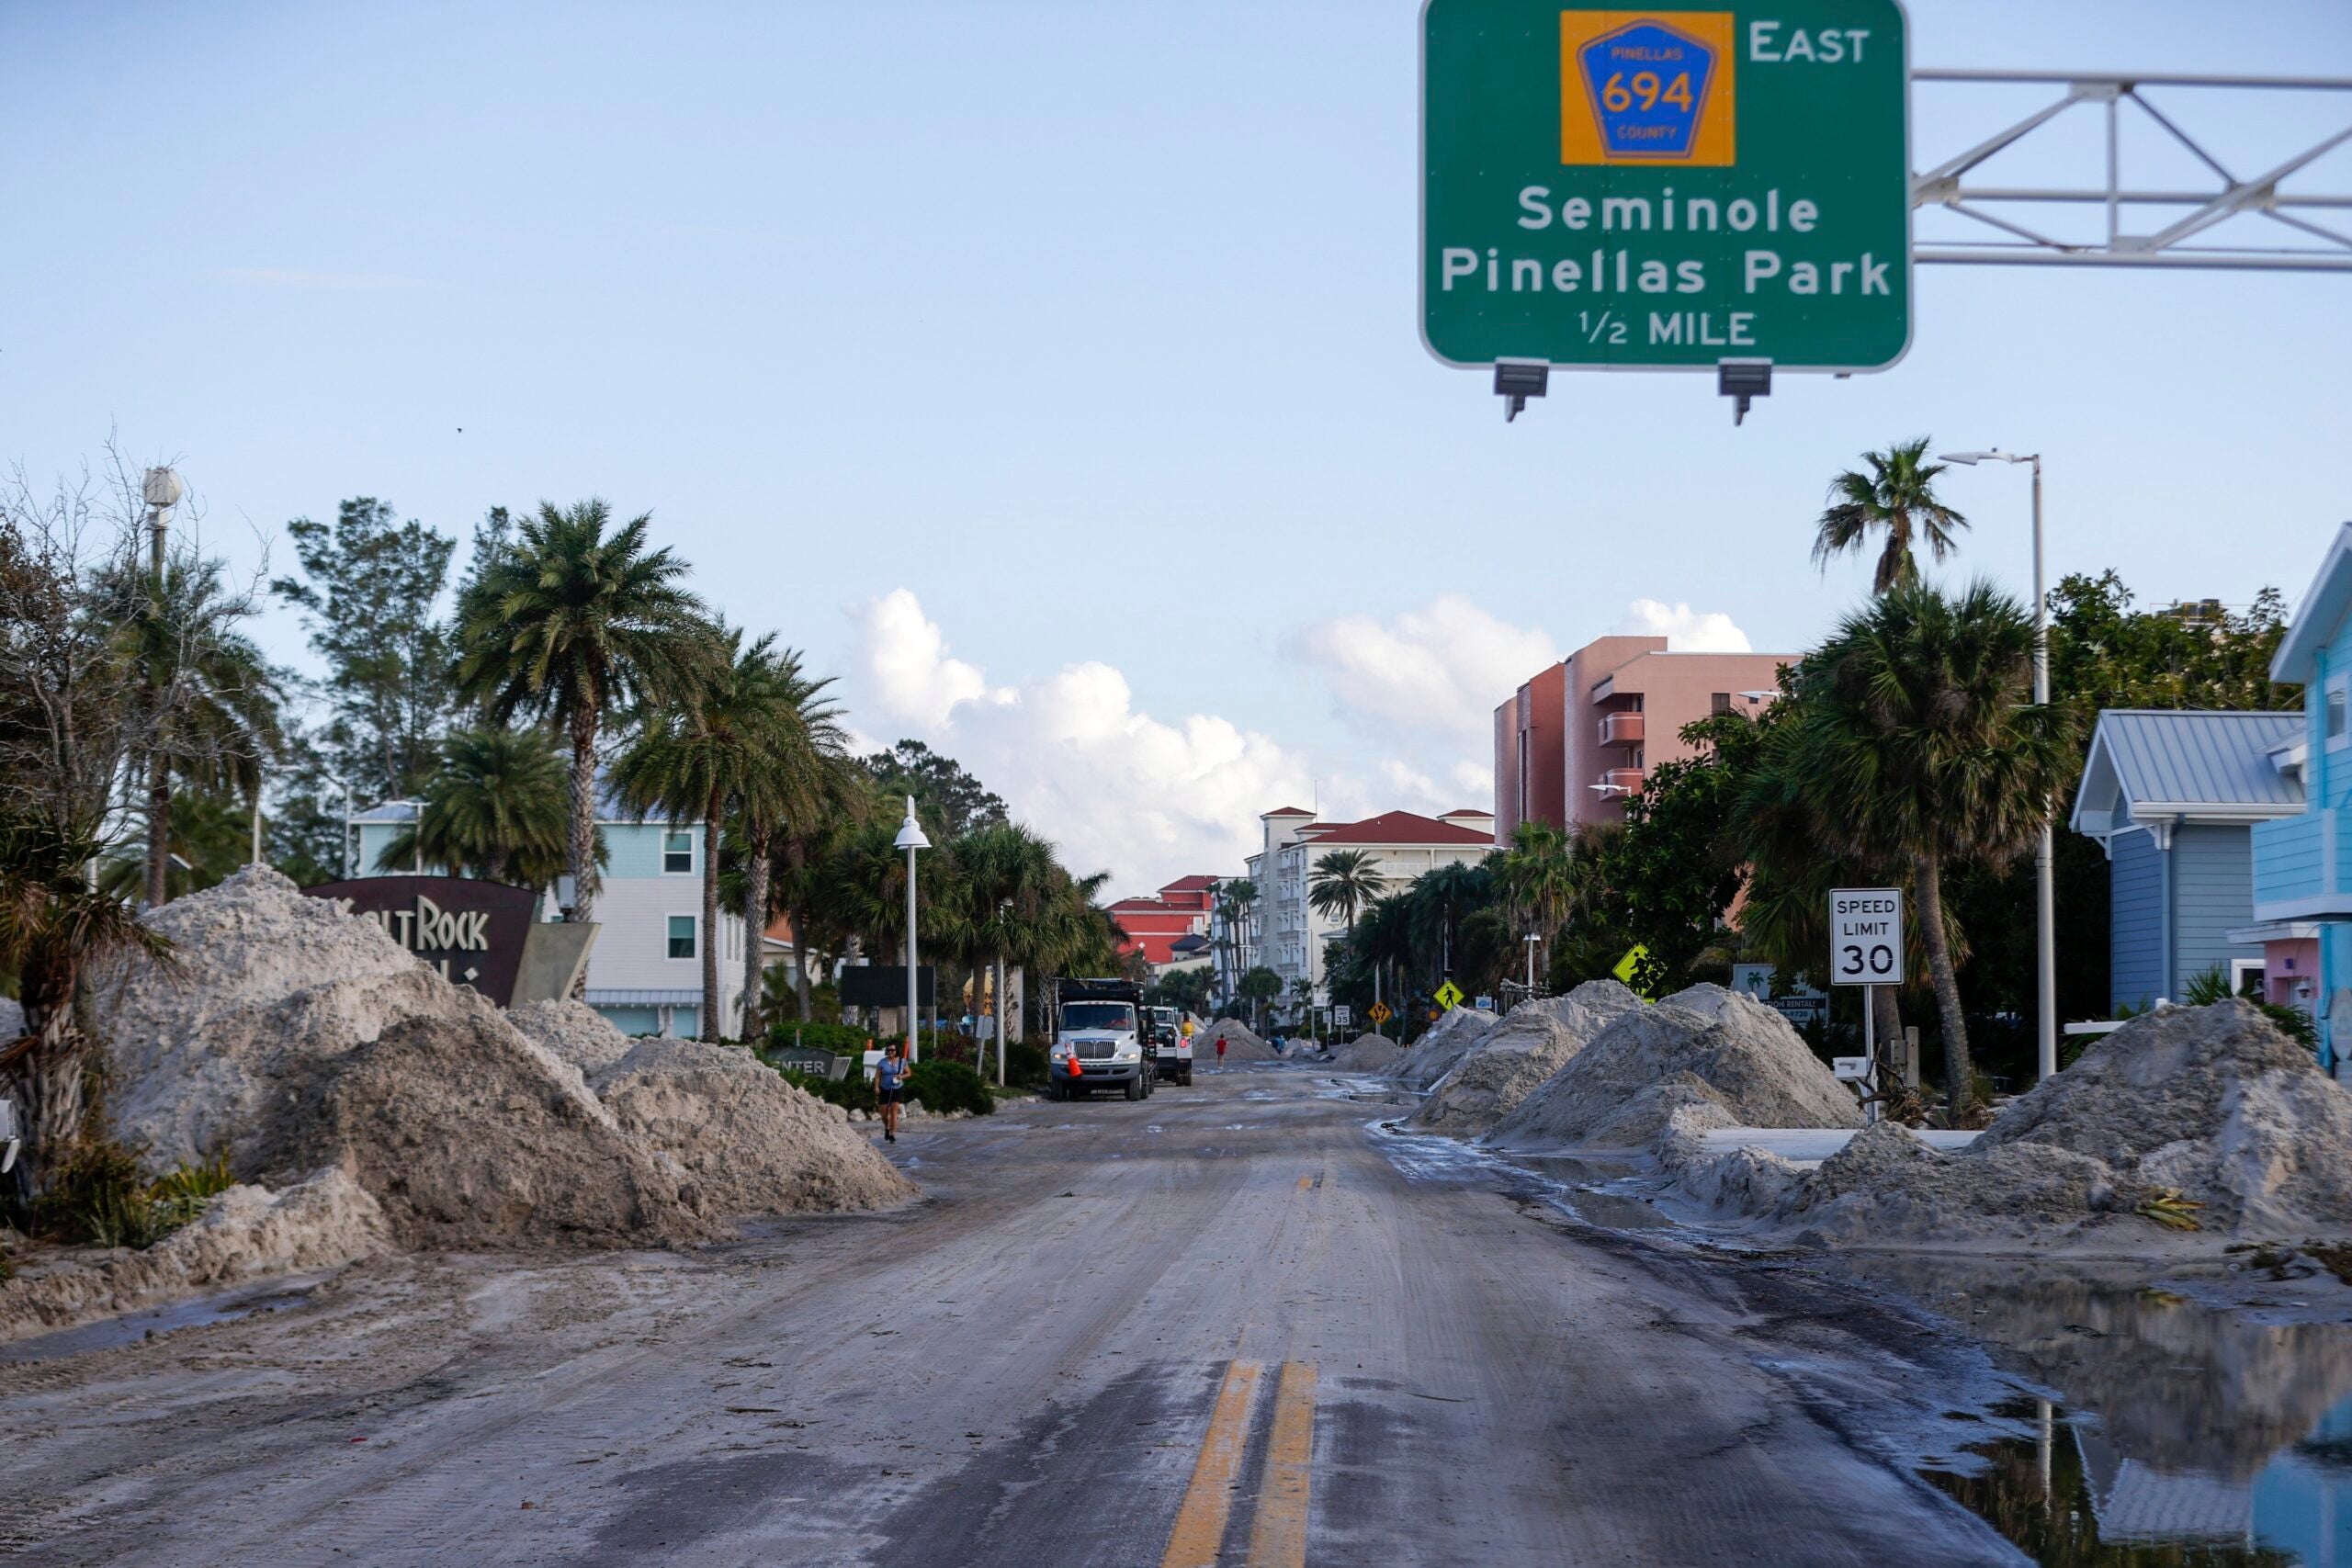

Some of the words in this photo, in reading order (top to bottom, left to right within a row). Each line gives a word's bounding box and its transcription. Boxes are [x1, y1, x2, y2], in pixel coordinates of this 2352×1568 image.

[1611, 47, 1683, 61] PINELLAS
[1749, 21, 1870, 62] EAST
[1602, 71, 1693, 113] 694
[1617, 125, 1677, 140] COUNTY
[1517, 186, 1818, 232] Seminole
[1442, 247, 1705, 292] Pinellas
[1745, 250, 1892, 296] Park
[1649, 312, 1756, 345] MILE
[1838, 900, 1894, 913] SPEED
[1844, 922, 1888, 935] LIMIT
[1841, 944, 1893, 975] 30
